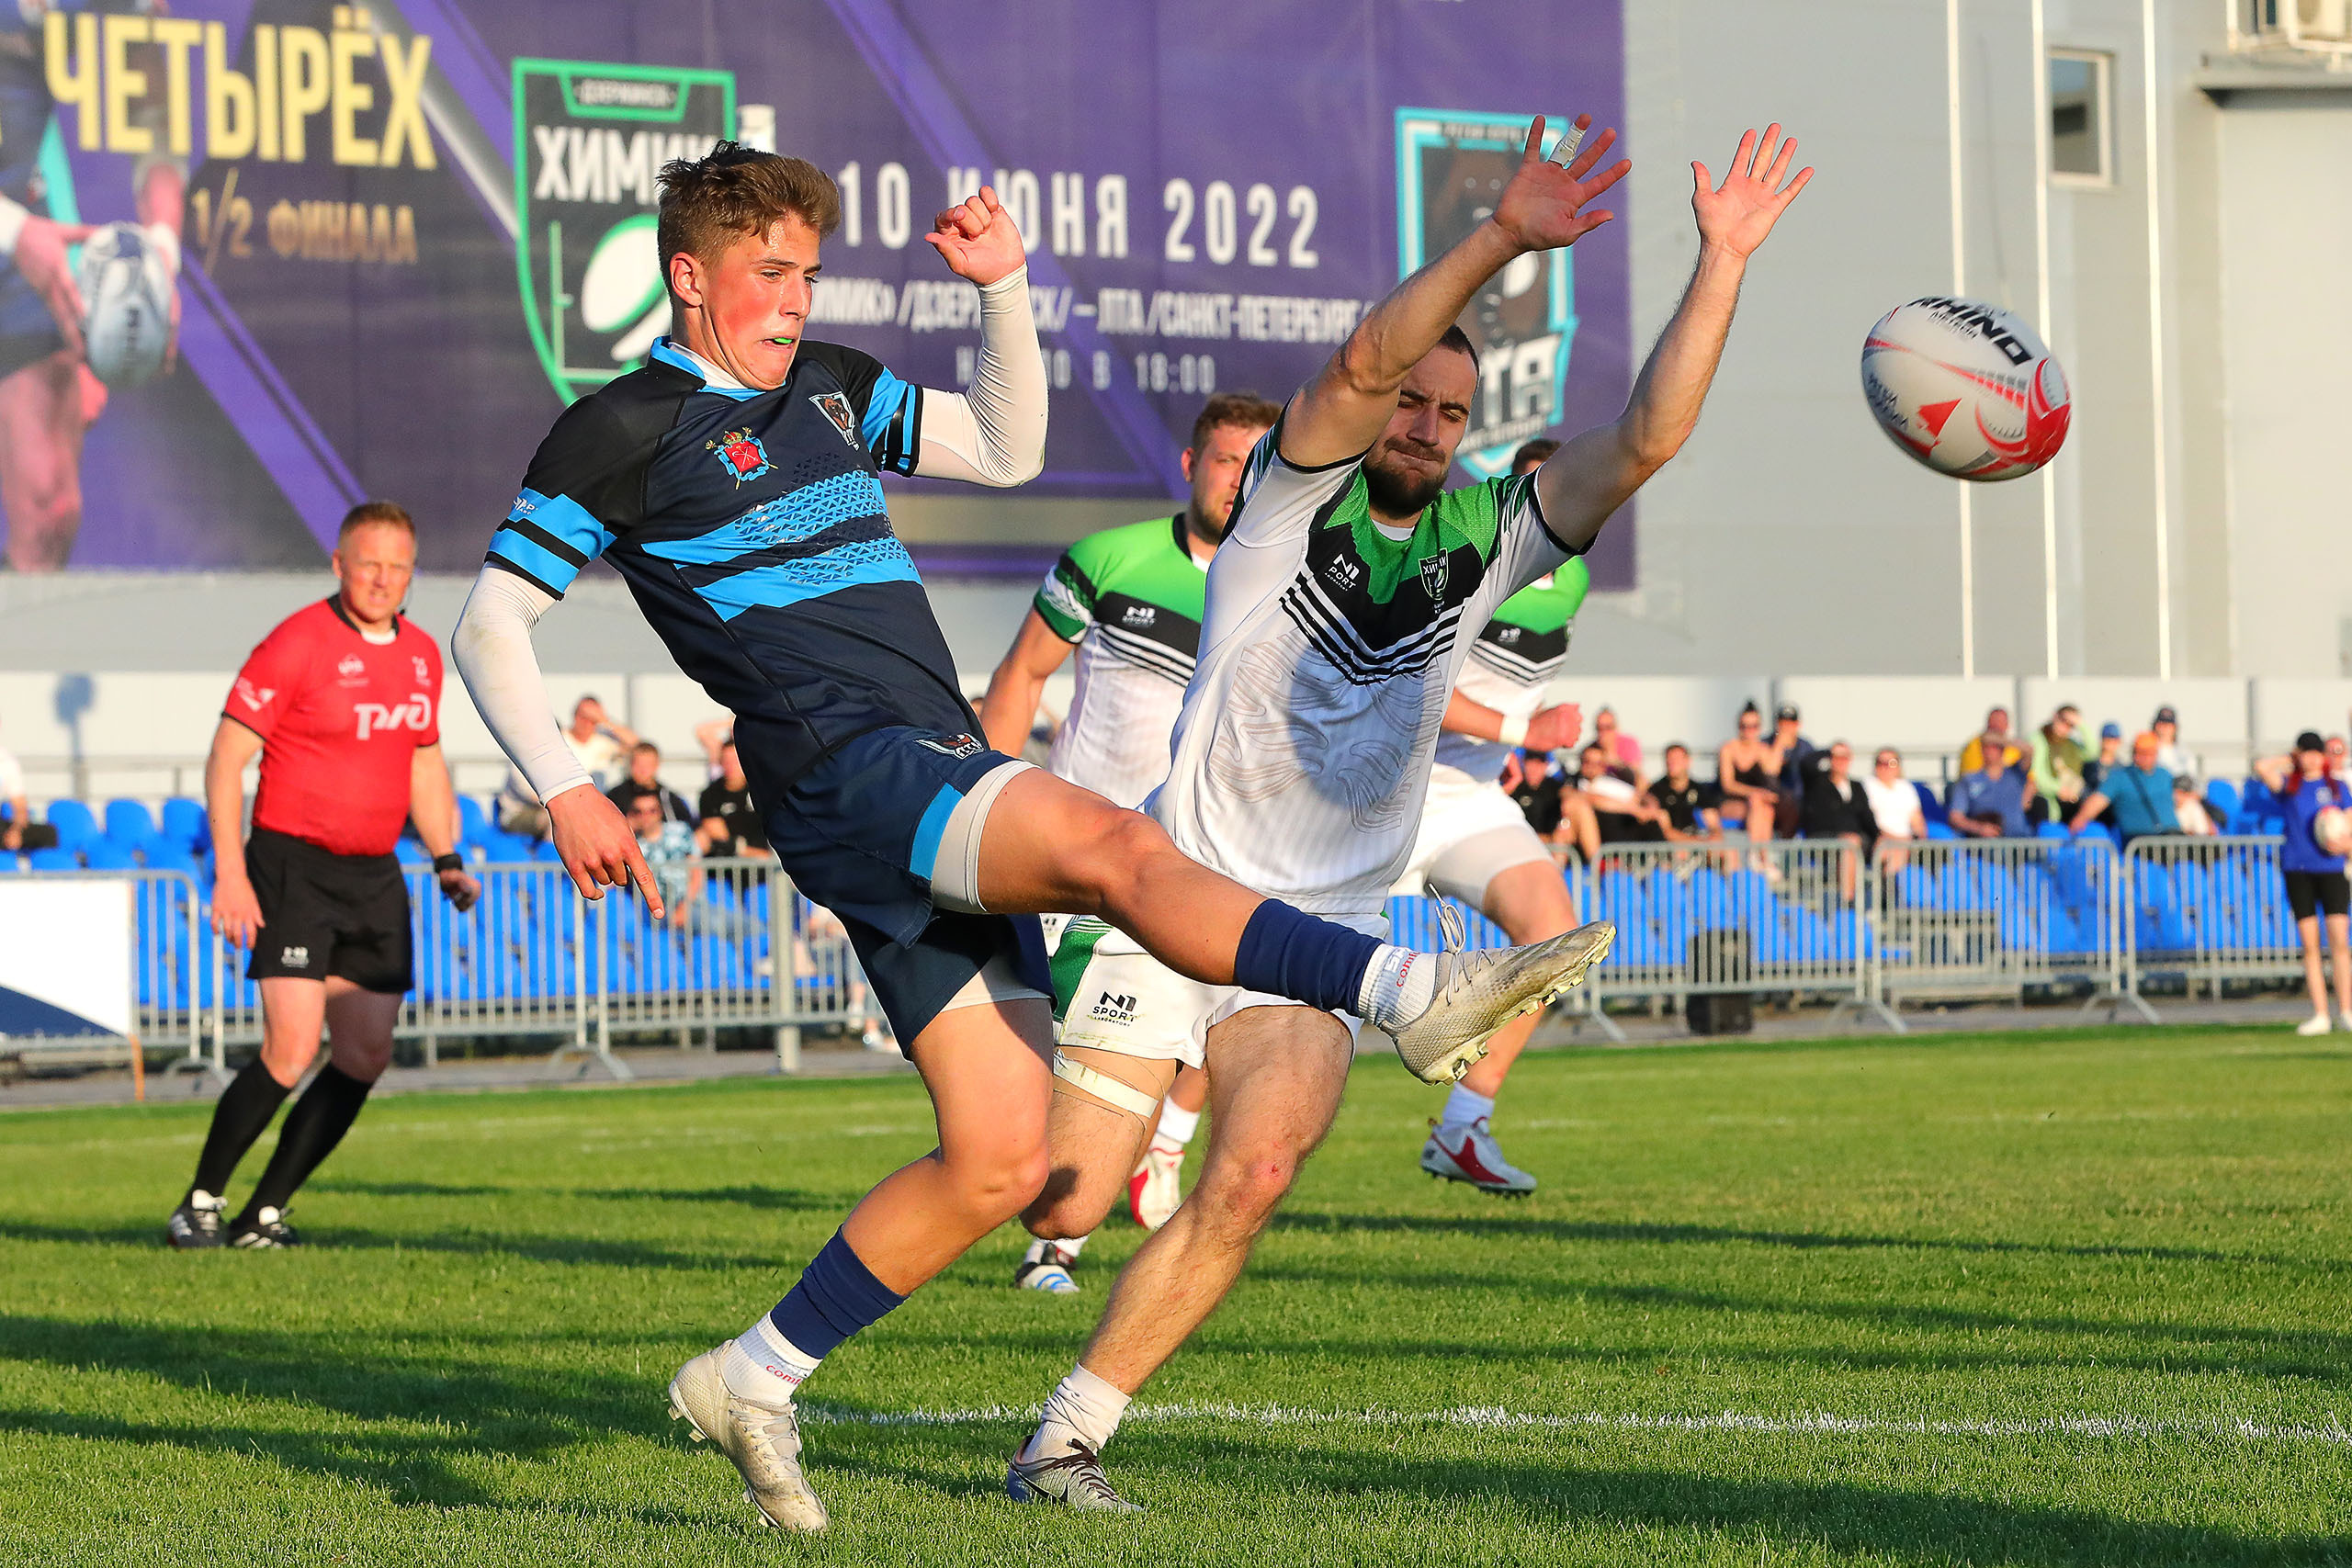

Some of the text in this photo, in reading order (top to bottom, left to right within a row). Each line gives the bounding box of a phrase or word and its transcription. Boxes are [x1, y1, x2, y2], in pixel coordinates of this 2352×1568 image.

[43, 5, 437, 171] ЧЕТЫРЁХ
[533, 123, 718, 207] ХИМ
[266, 198, 419, 265] ФИНАЛА
[837, 160, 911, 250] 10
[1163, 176, 1319, 269] 2022
[1135, 351, 1216, 394] 18:00
[1478, 333, 1560, 429] ТА
[1328, 566, 1357, 589] PORT
[1092, 1006, 1135, 1022] SPORT
